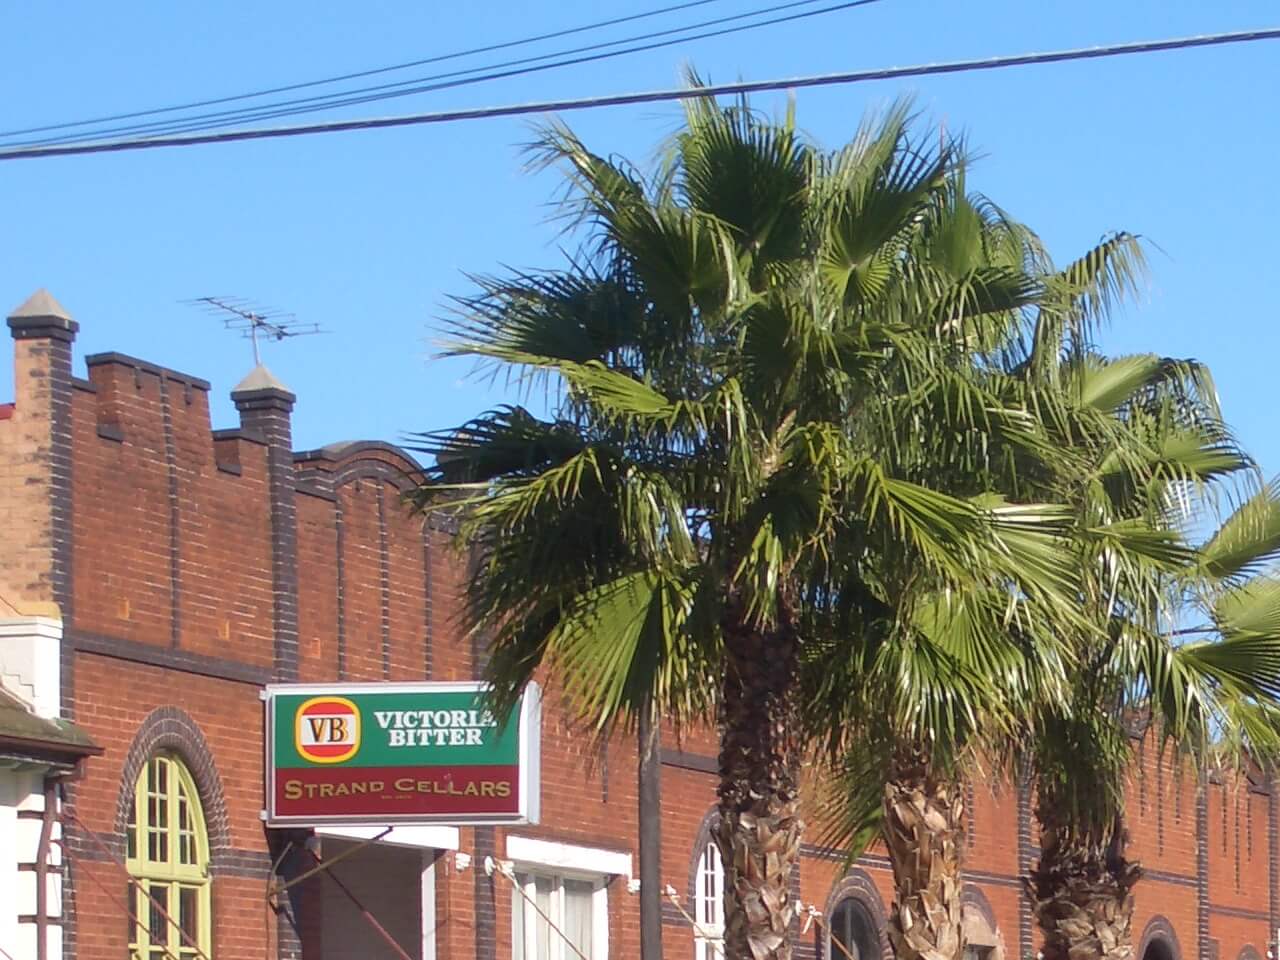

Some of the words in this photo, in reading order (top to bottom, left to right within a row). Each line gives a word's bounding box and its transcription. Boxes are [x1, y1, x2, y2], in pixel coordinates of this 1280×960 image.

[308, 717, 349, 743] VB
[388, 728, 484, 747] BITTER
[284, 779, 385, 800] STRAND
[395, 778, 512, 797] CELLARS
